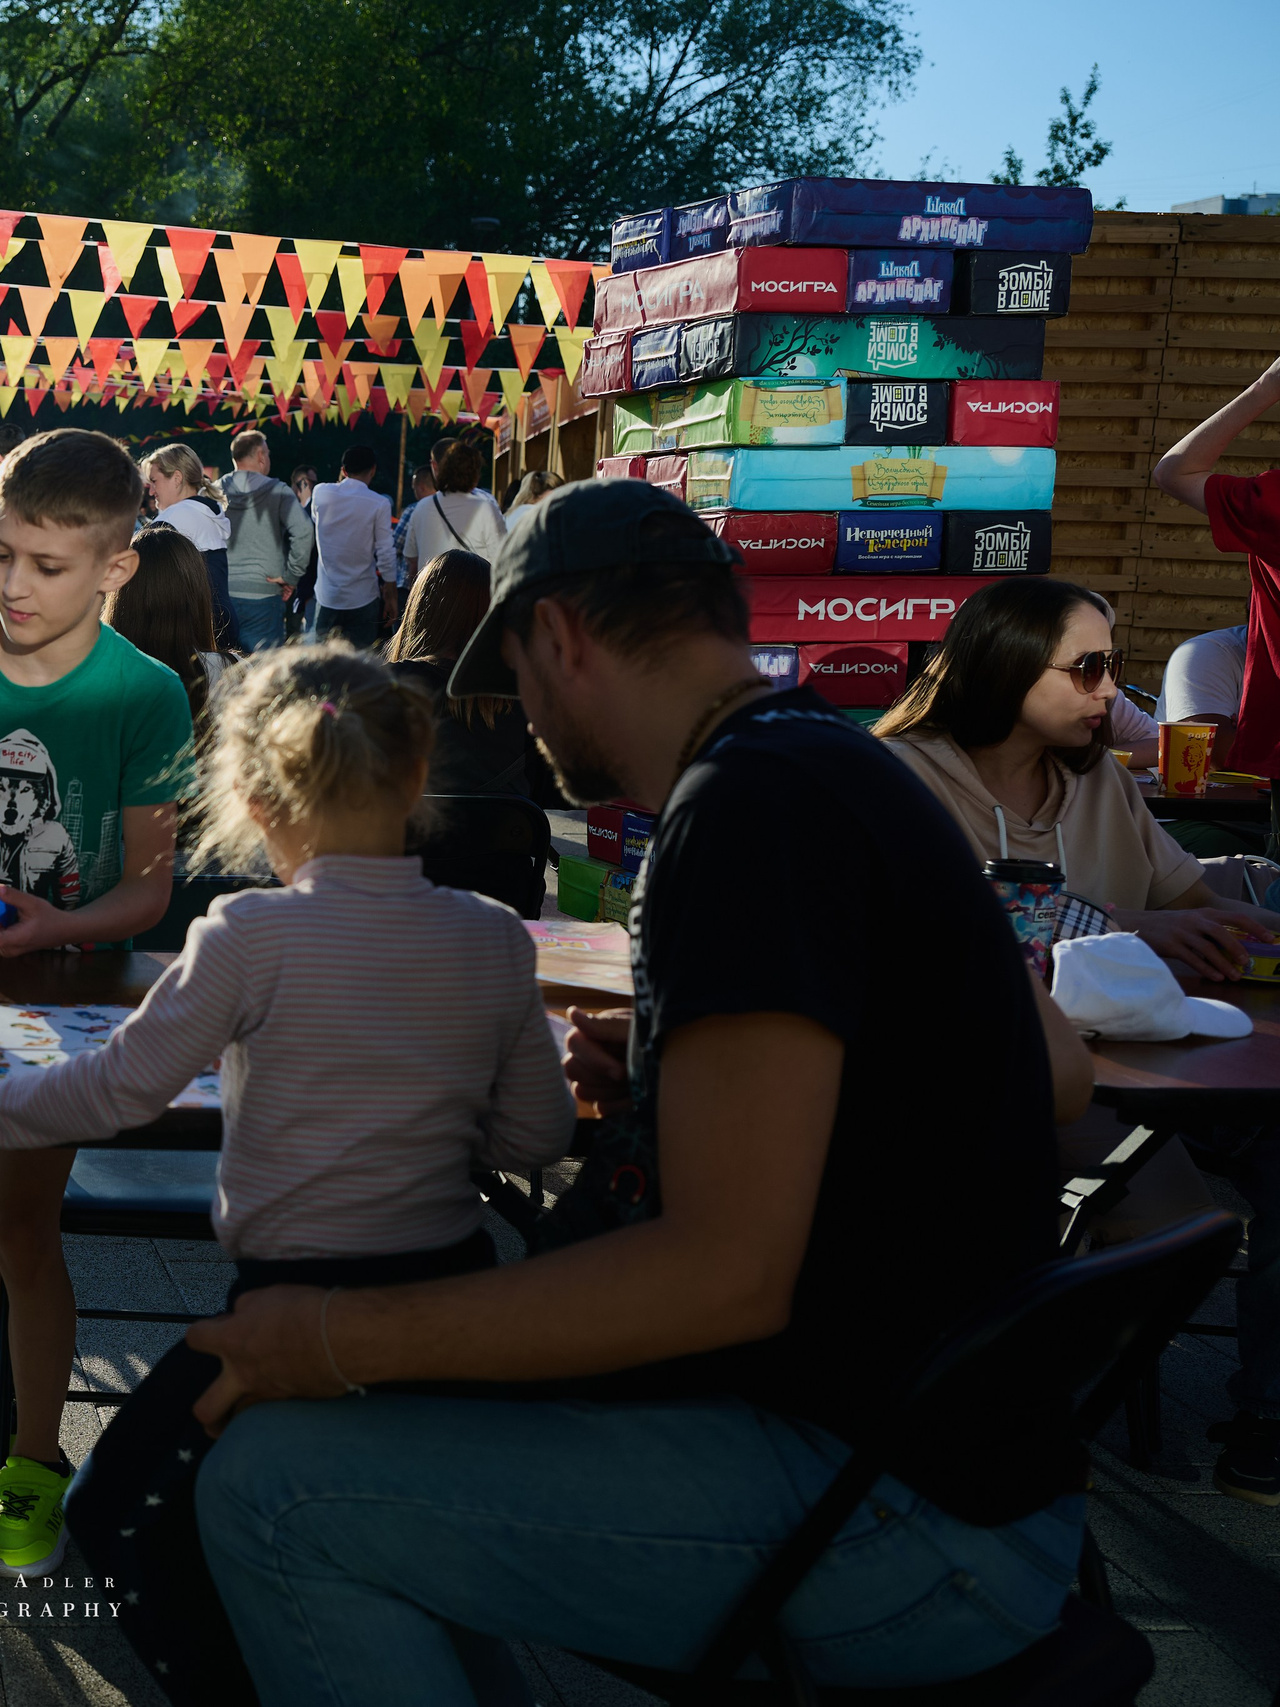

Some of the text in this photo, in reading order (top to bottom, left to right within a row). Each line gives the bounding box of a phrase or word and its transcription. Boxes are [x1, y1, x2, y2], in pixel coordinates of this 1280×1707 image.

[897, 215, 988, 246] АРХИПЕЛАГ
[751, 281, 838, 293] МОСИГРА
[999, 271, 1053, 291] ЗОМБИ
[621, 279, 704, 314] МОСИГРА
[855, 277, 943, 304] АРХИПЕЛАГ
[997, 290, 1050, 309] В ДОМЕ
[870, 325, 919, 343] В ДОМЕ
[867, 342, 918, 361] ЗОМБИ
[872, 385, 927, 402] В ДОМЕ
[871, 402, 928, 421] ЗОМБИ
[966, 401, 1053, 414] МОСИГРА
[738, 538, 824, 550] МОСИГРА
[865, 537, 928, 553] Телефон
[974, 532, 1031, 551] ЗОМБИ
[973, 550, 1029, 568] В ДОМЕ
[809, 662, 898, 674] МОСИГРА
[2, 750, 15, 758] Big
[588, 825, 618, 842] МОСИГРА
